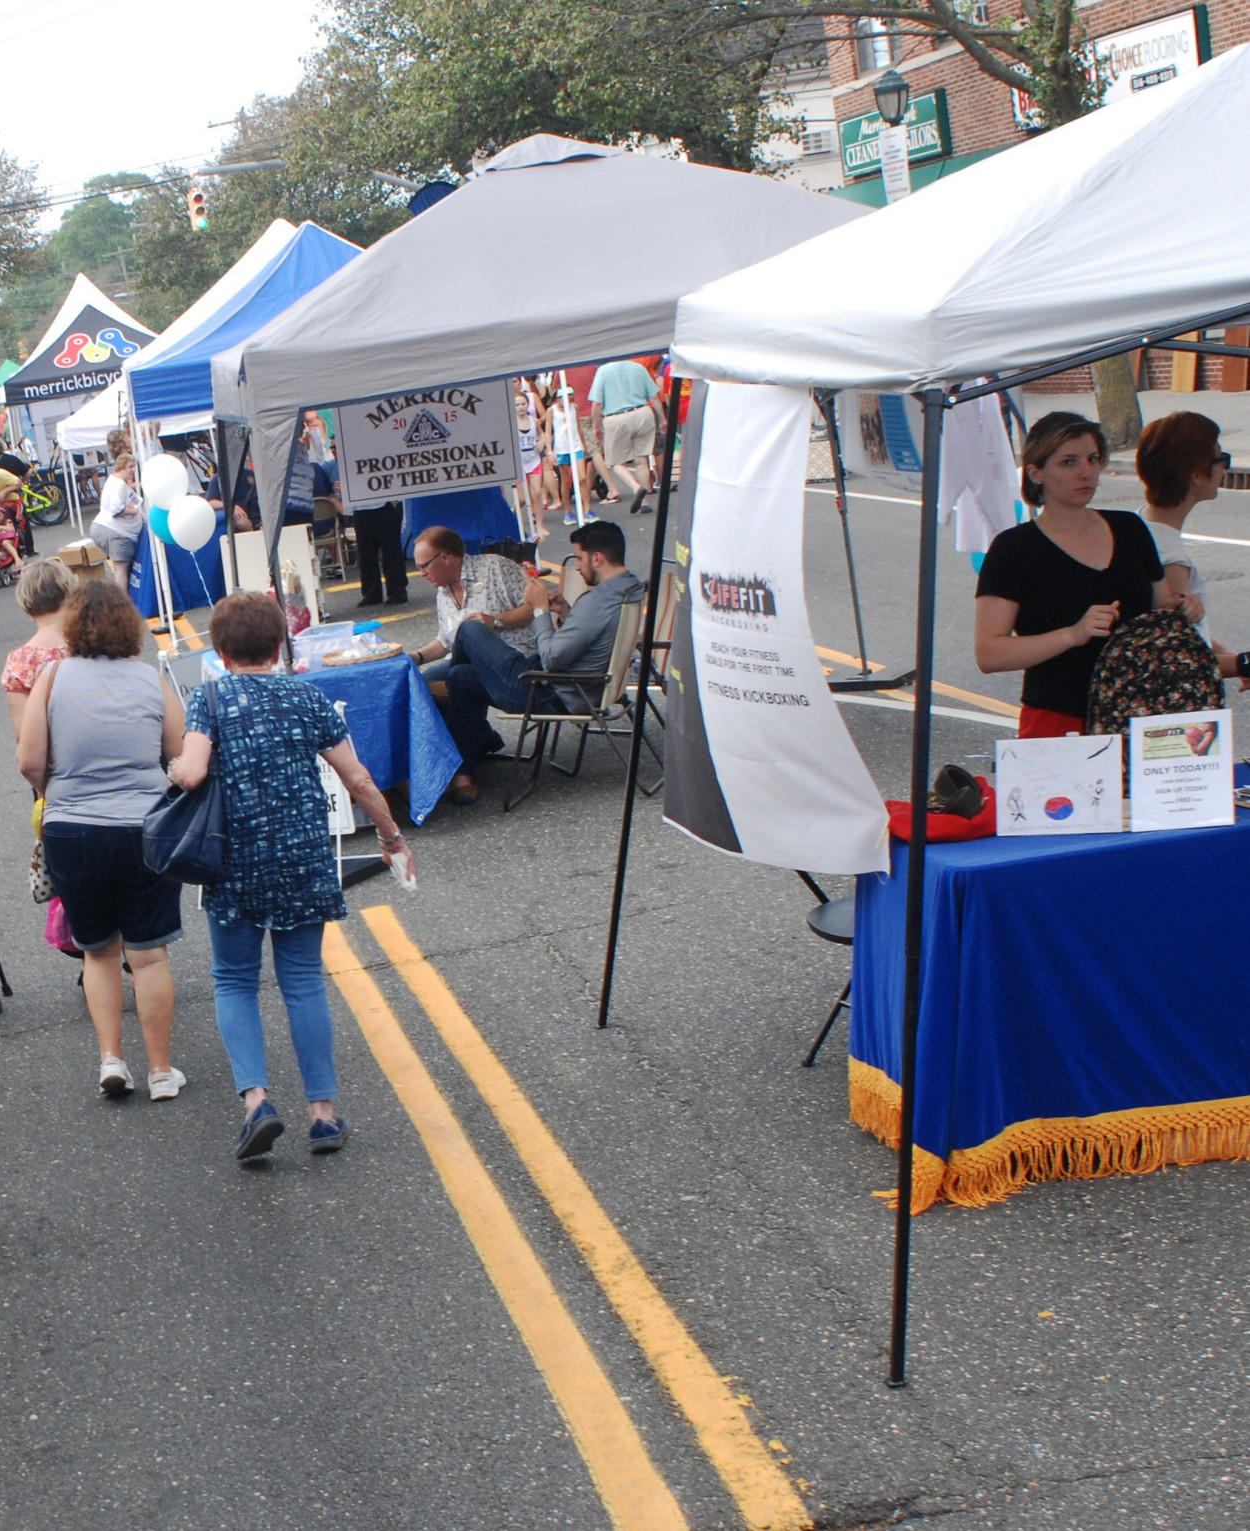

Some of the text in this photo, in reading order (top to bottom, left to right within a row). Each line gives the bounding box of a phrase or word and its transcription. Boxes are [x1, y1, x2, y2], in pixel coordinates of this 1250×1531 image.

[907, 122, 940, 152] AILORS
[392, 411, 458, 431] 20 15
[354, 440, 505, 476] PROFESSIONAL
[366, 460, 497, 492] OF THE YEAR
[710, 641, 780, 662] REACH YOUR FITNESS
[705, 654, 796, 678] GOALS FOR THE FIRST TIME
[707, 680, 741, 700] FITNESS
[741, 689, 810, 707] KICKBOXING
[1143, 761, 1220, 776] ONLY TODAY!!!
